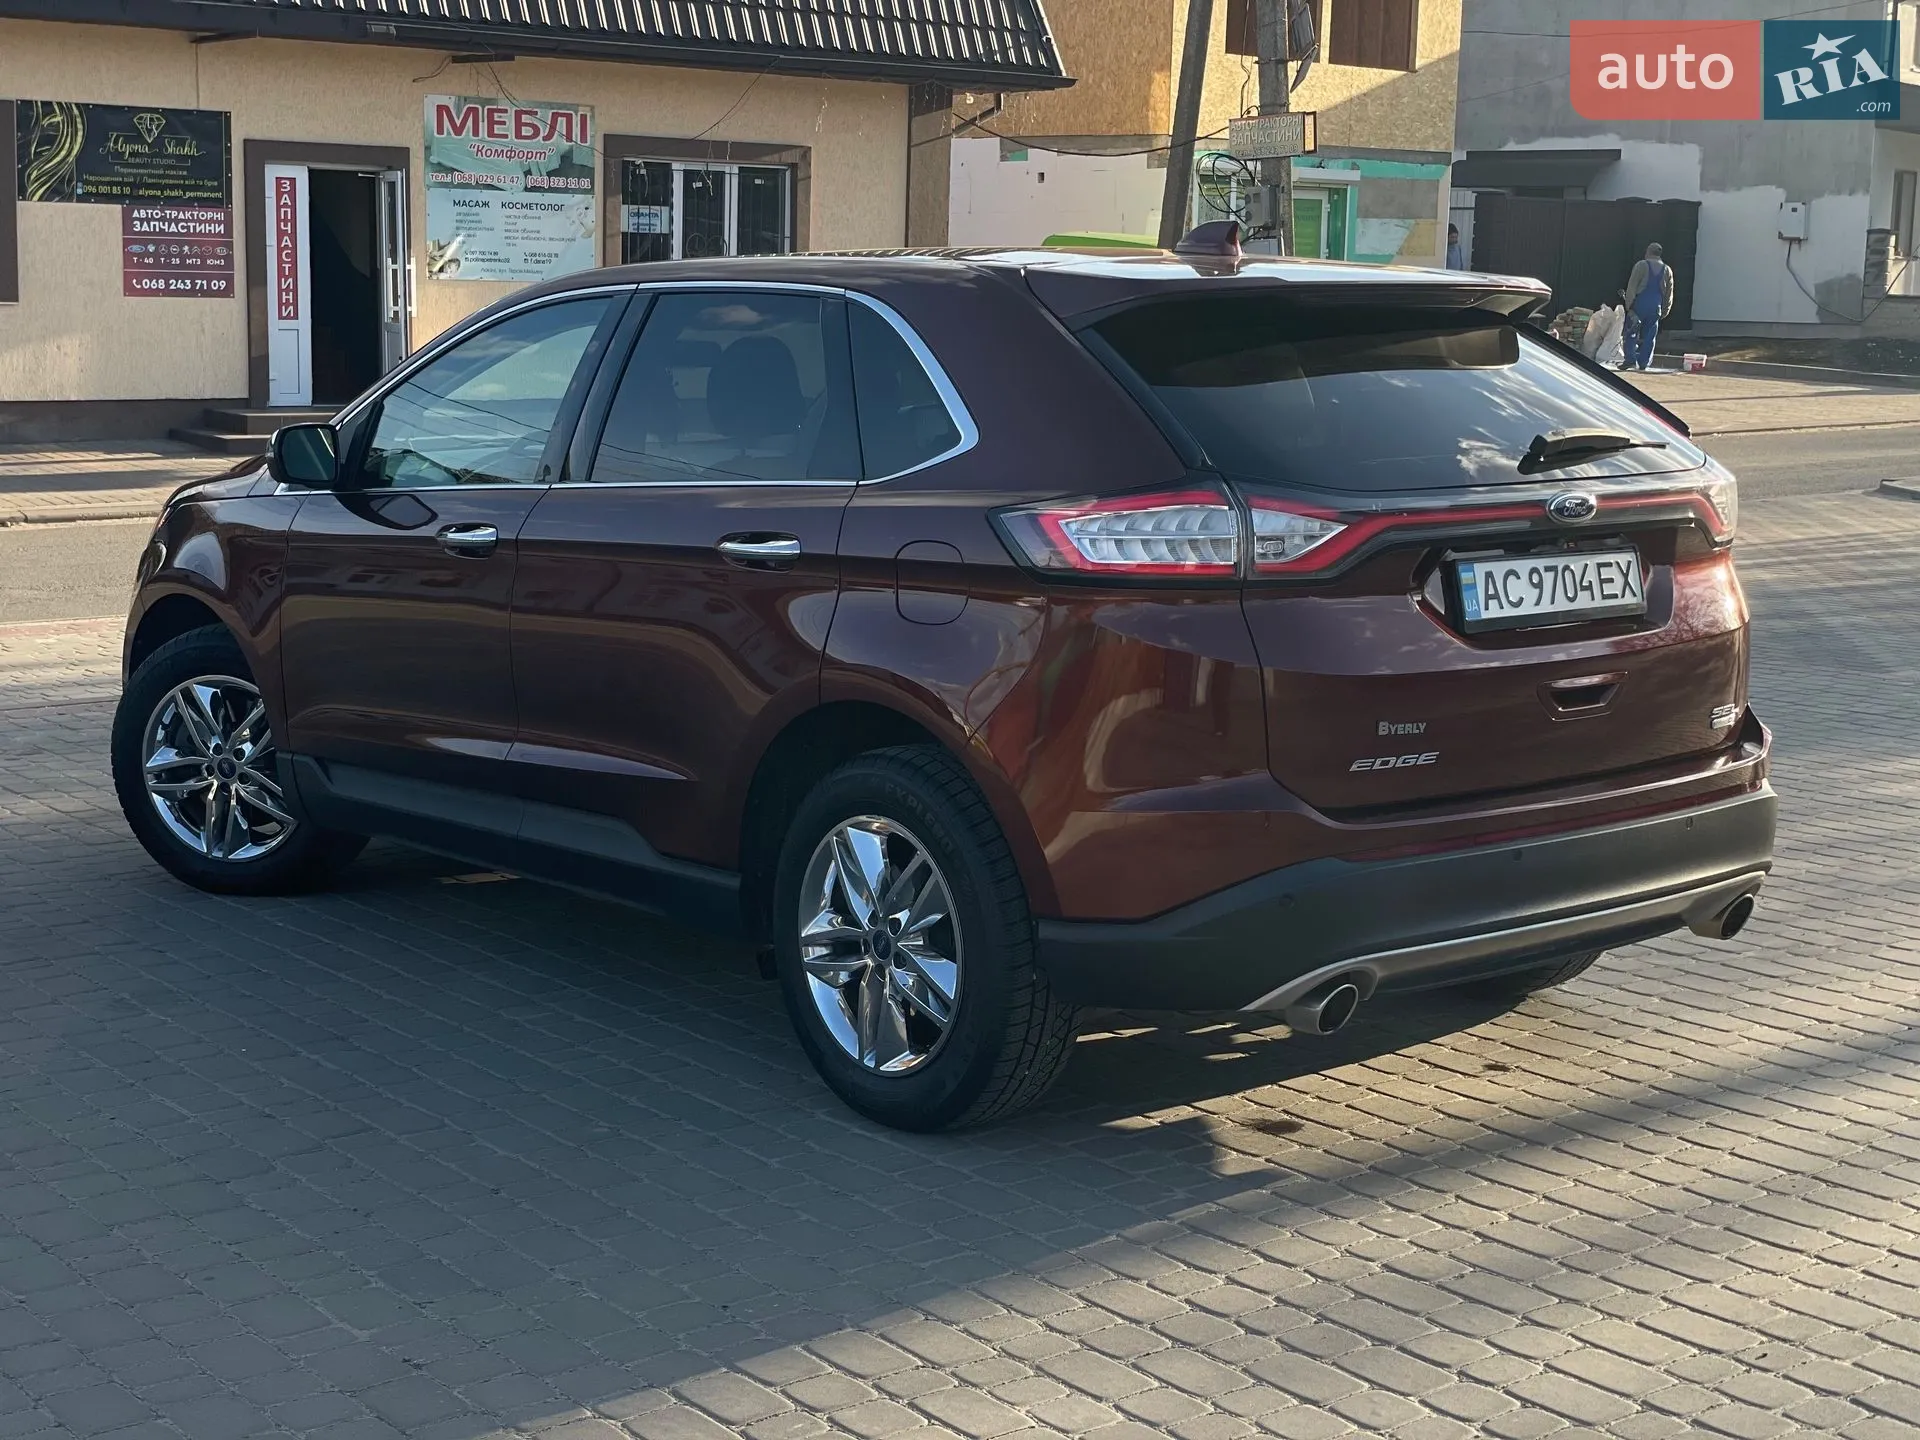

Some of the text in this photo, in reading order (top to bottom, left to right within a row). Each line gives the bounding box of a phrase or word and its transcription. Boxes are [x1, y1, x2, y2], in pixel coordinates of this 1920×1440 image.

[435, 104, 589, 144] МЕБЛІ
[1231, 128, 1301, 145] ЗАПЧАСТИНИ
[163, 138, 206, 156] Shakh
[128, 157, 176, 166] BEAUTY STUDIO
[431, 173, 451, 181] тел.:
[453, 172, 477, 183] (068)
[478, 174, 494, 183] 029
[497, 175, 506, 183] 61
[527, 176, 549, 187] (068)
[550, 178, 565, 187] 323
[568, 178, 577, 187] 11
[580, 179, 591, 188] 01
[83, 186, 97, 194] 096
[98, 186, 111, 194] 001
[112, 186, 121, 194] 85
[453, 199, 490, 208] МАСАЖ
[501, 201, 565, 212] КОСМЕТОЛОГ
[132, 209, 224, 221] АВТО-ТРАКТОРНІ
[132, 221, 225, 234] ЗАПЧАСТИНИ
[280, 180, 294, 317] ЗАПЧАСТИНИ
[142, 279, 226, 290] 068 243 71 09
[1563, 499, 1591, 516] Ford
[1465, 600, 1479, 613] UA
[1349, 752, 1440, 771] EDGE
